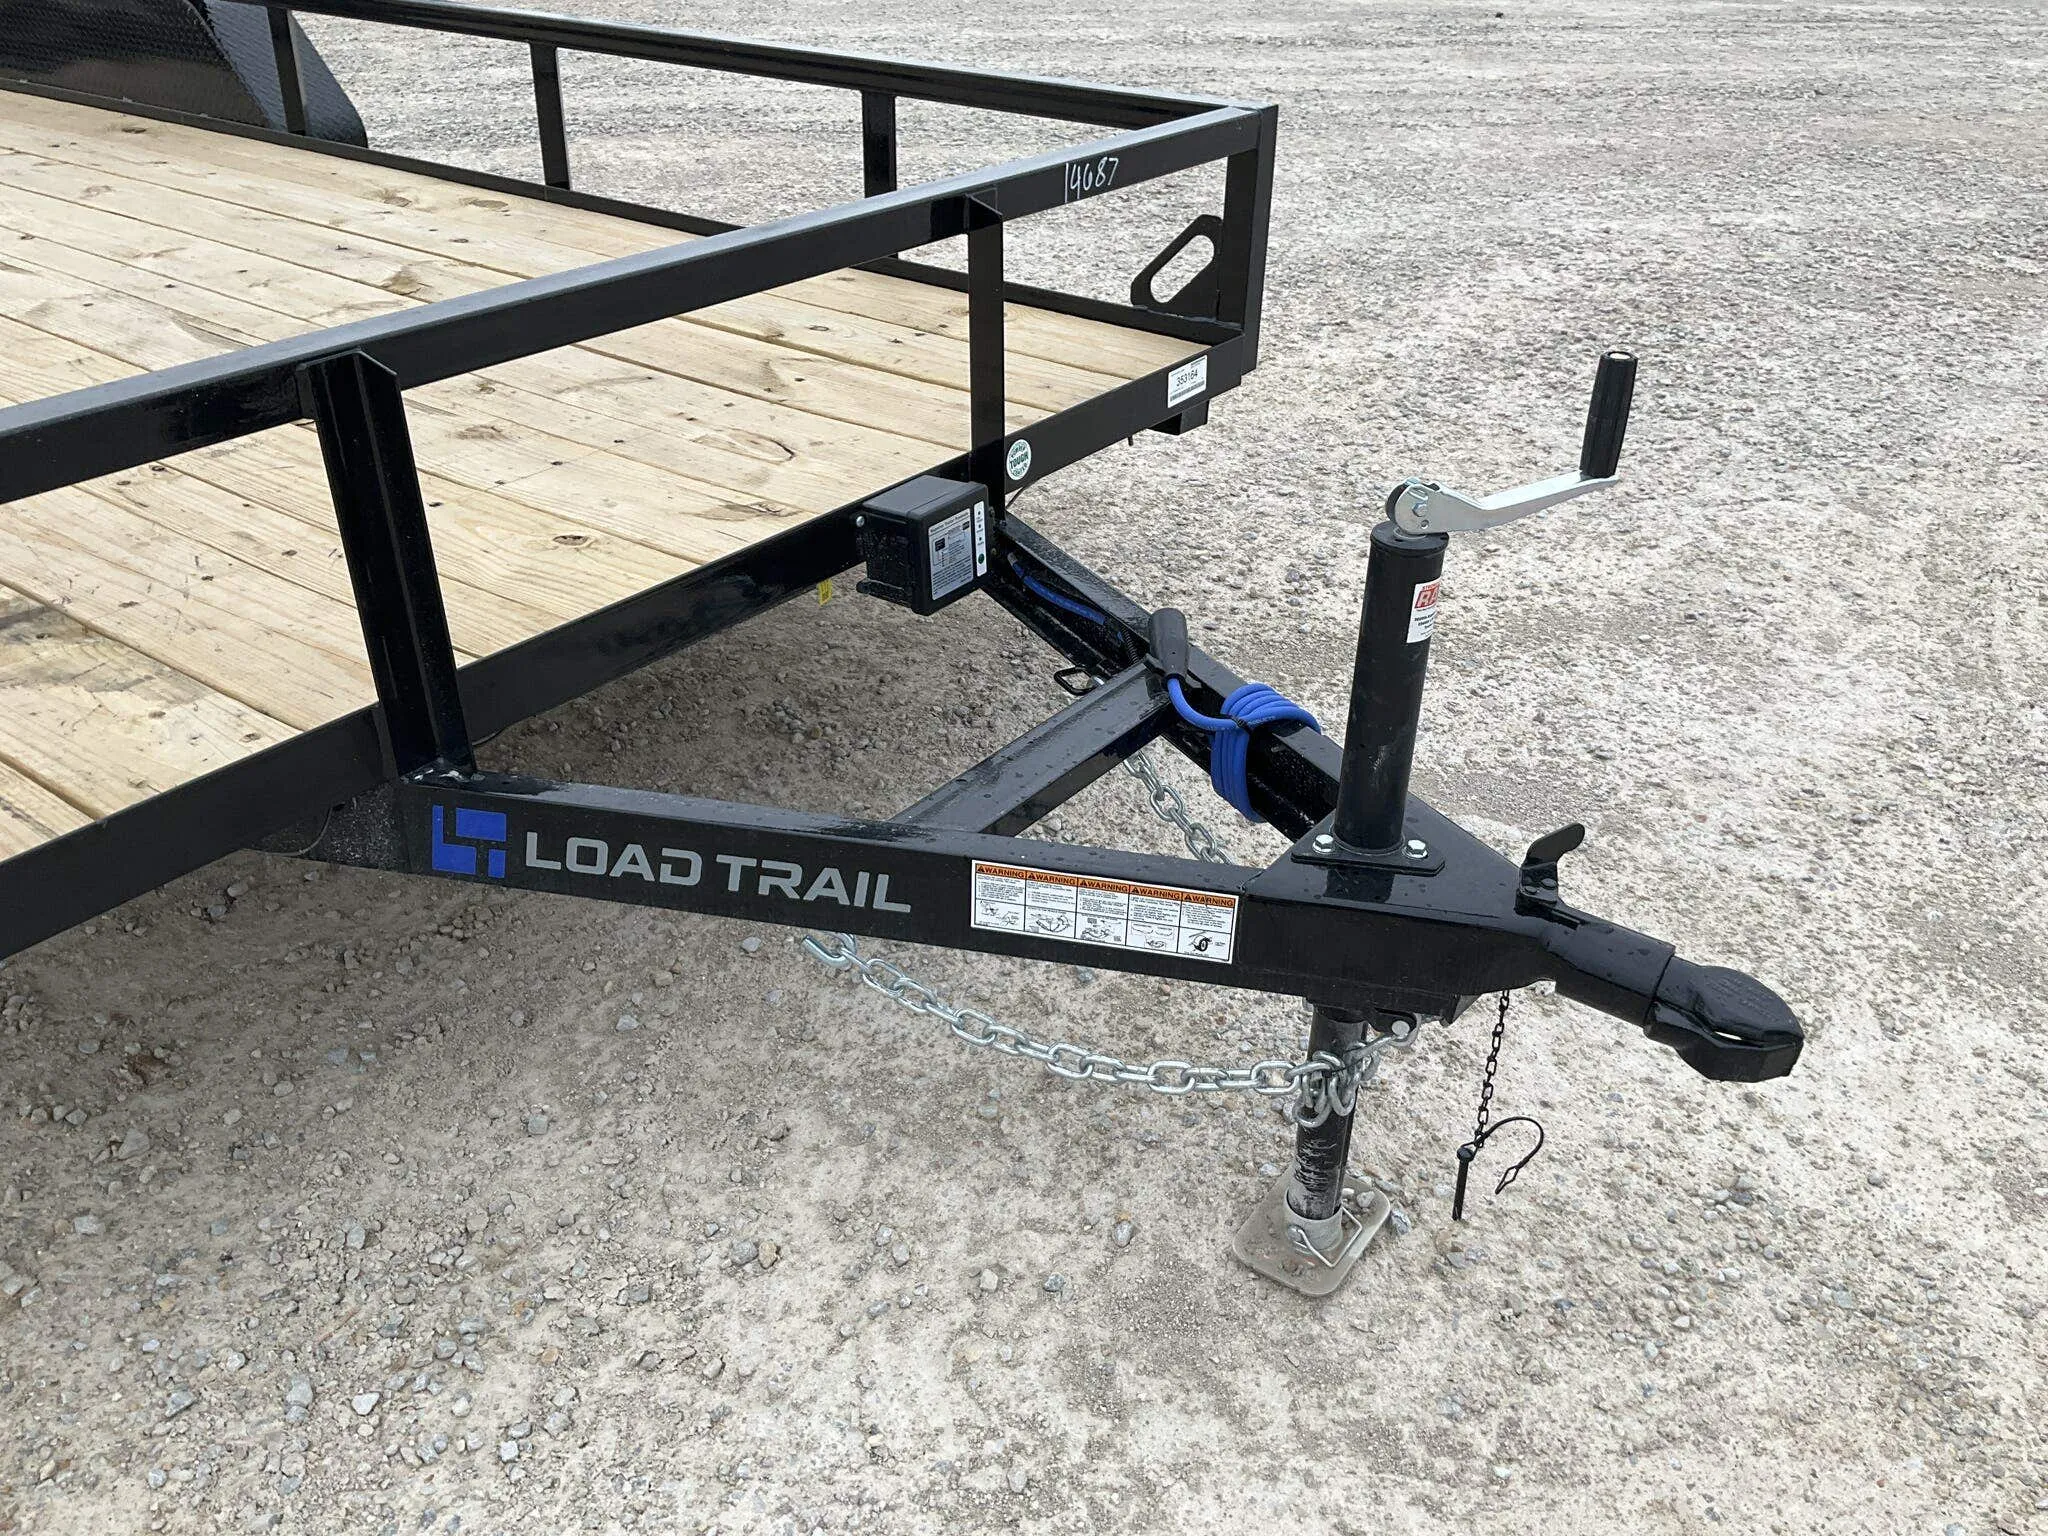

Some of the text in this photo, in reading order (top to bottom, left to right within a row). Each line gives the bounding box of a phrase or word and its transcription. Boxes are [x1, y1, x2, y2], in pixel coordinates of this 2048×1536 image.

[1064, 156, 1119, 204] 14687
[1176, 369, 1198, 387] 353164
[525, 831, 702, 885] LOAD
[716, 853, 912, 913] TRAIL
[984, 866, 1026, 879] WARNING
[1035, 873, 1076, 886] WARNING
[1086, 881, 1128, 893] WARNING
[1139, 888, 1181, 901] WARNING
[1192, 895, 1235, 907] WARNING
